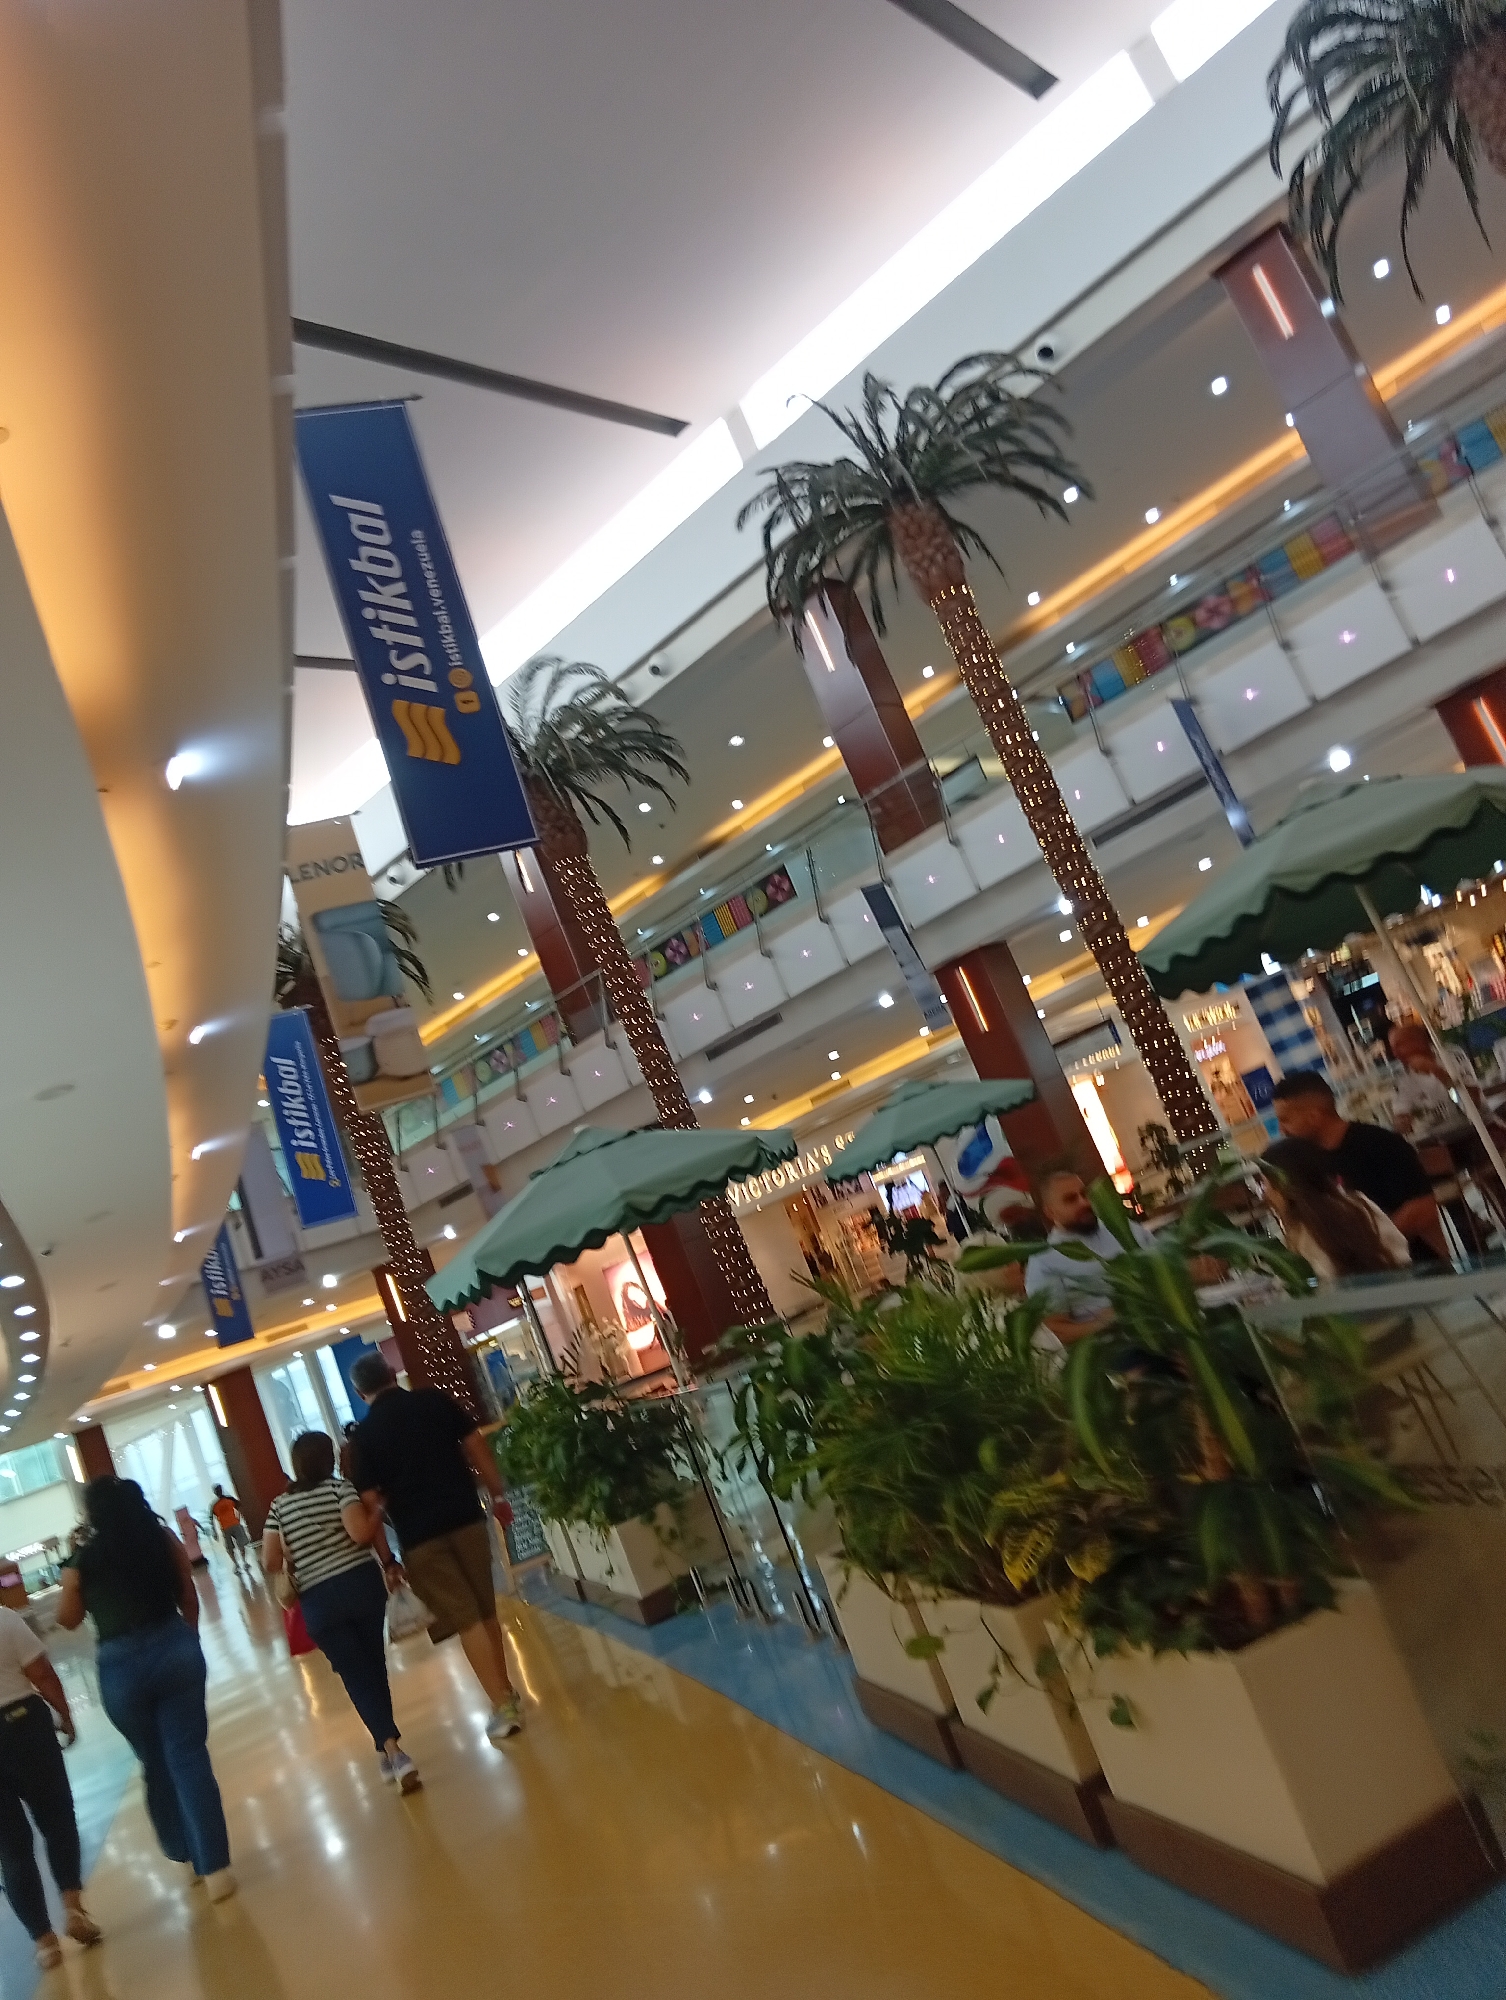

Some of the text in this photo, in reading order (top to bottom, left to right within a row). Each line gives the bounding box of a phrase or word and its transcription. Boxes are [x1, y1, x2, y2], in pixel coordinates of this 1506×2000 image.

[327, 494, 439, 693] istikbal
[409, 528, 464, 667] istikbal.venezuela
[269, 1055, 318, 1149] istikbal
